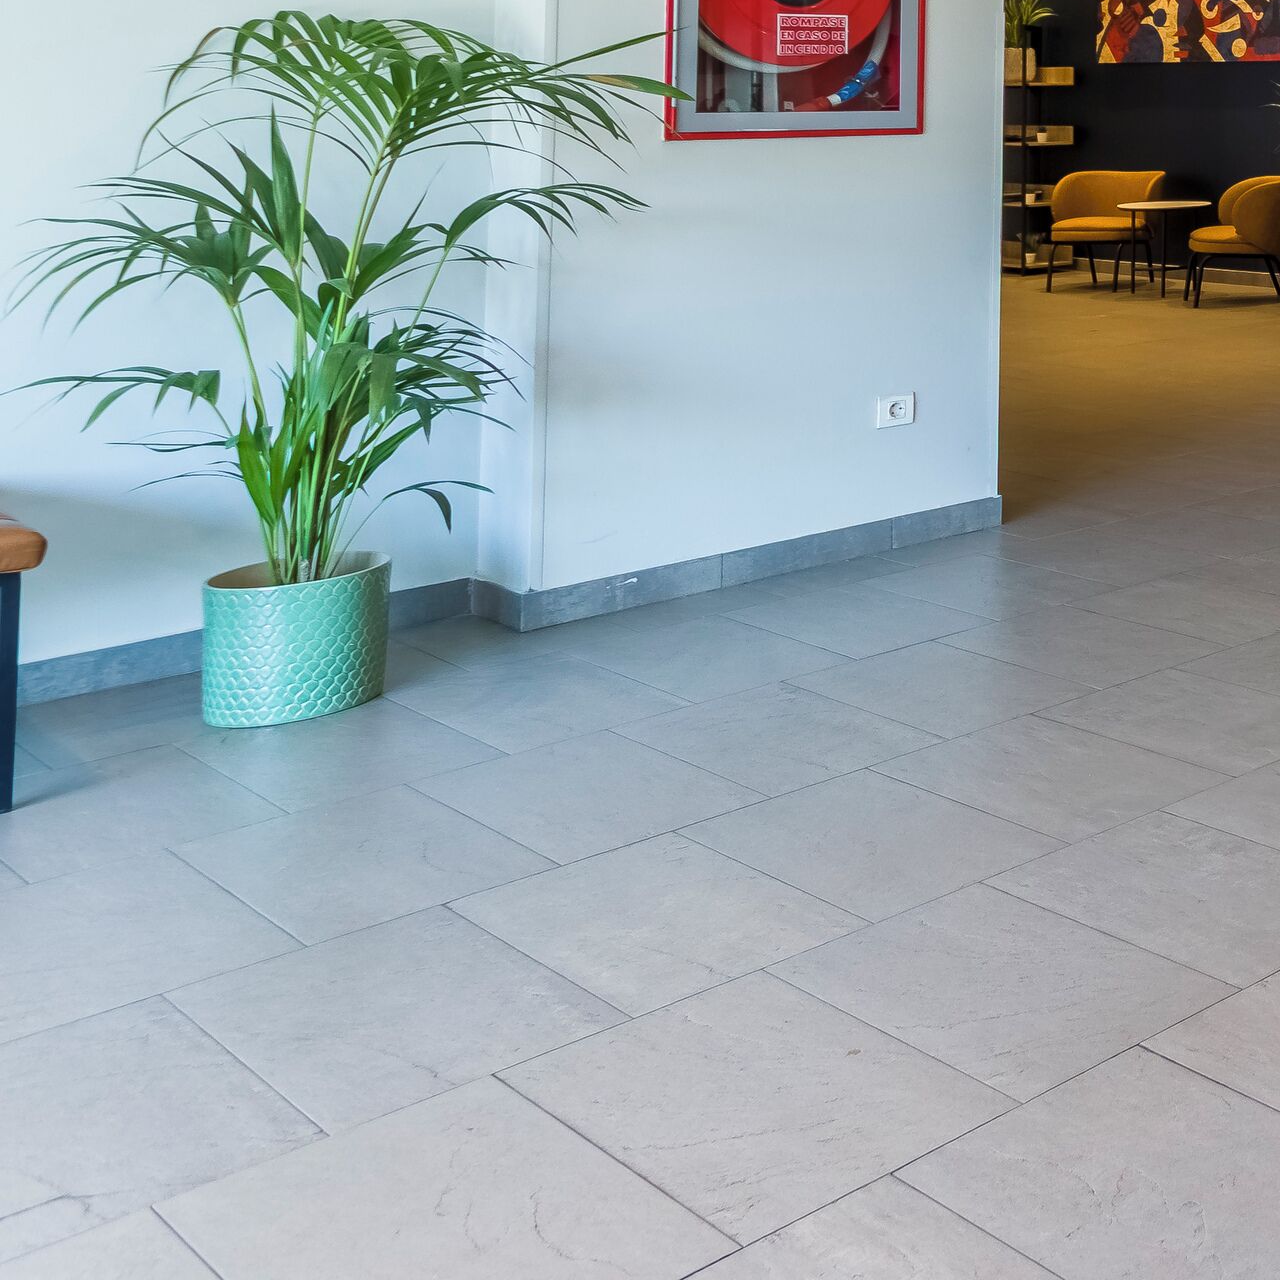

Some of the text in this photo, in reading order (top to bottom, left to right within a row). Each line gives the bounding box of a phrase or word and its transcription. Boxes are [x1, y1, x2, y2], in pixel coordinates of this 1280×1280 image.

[781, 16, 846, 28] ROMPASE
[780, 29, 846, 41] EN CASO DE
[780, 44, 846, 55] INCENDIO
